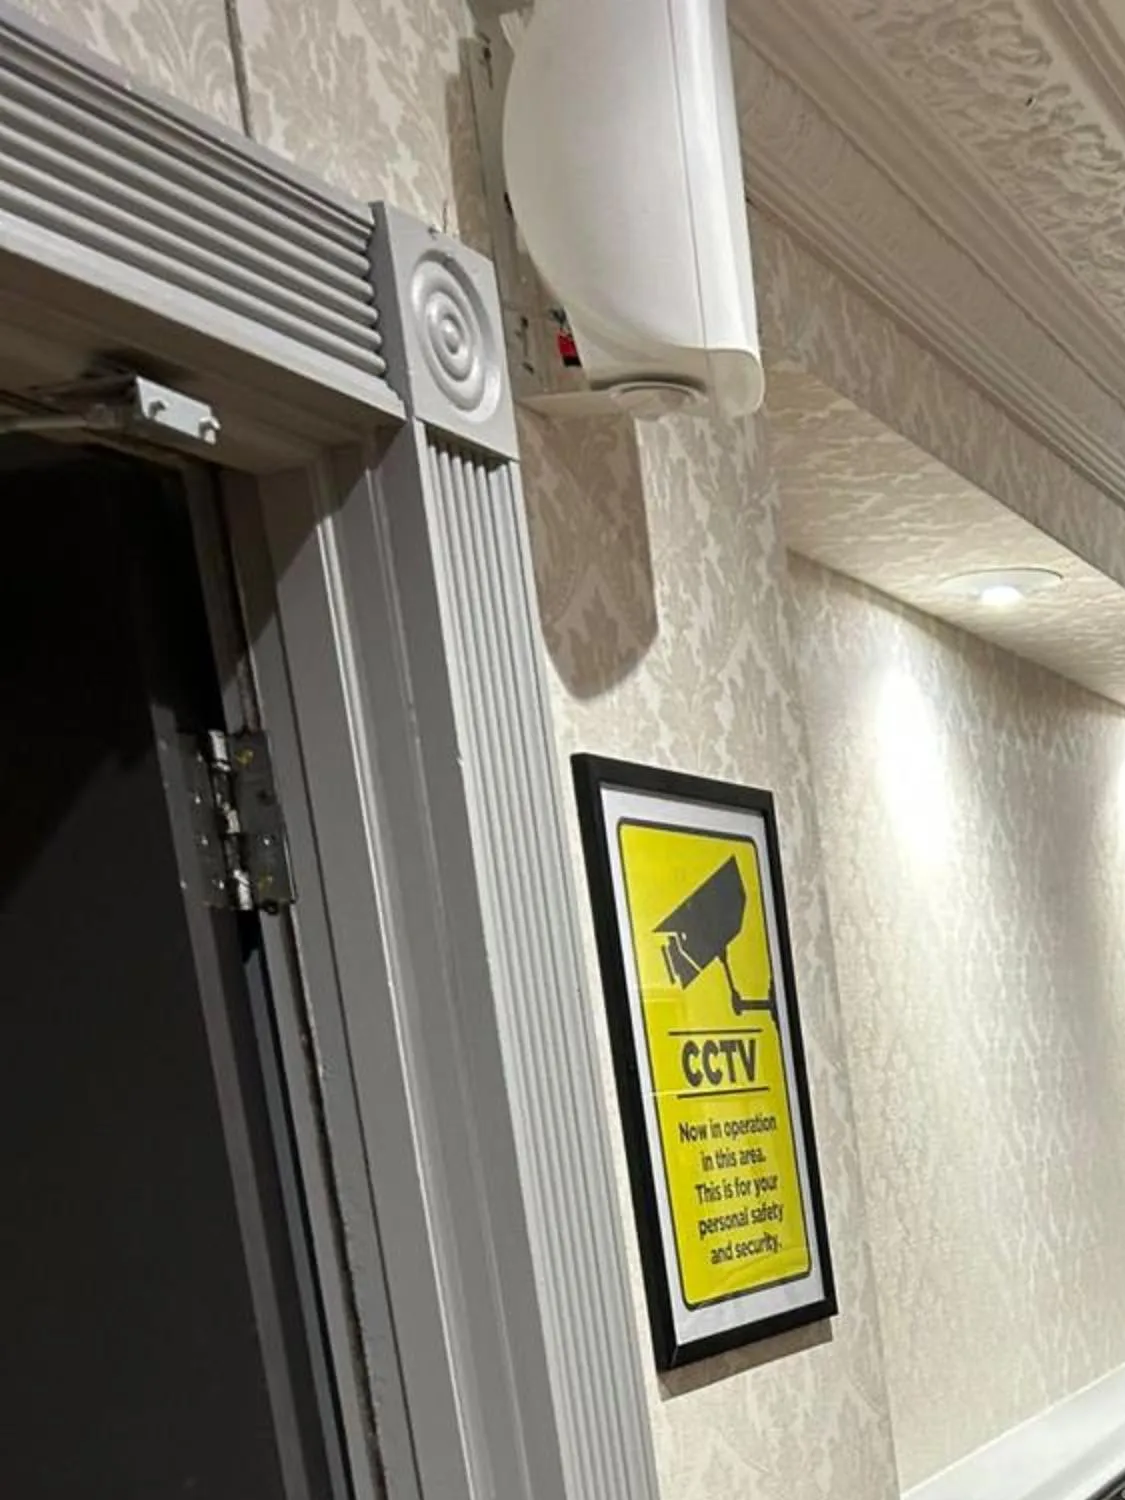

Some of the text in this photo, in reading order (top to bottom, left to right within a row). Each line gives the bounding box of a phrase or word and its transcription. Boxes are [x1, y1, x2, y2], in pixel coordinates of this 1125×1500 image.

[682, 1039, 756, 1087] CCTV
[679, 1113, 777, 1142] Now in operation
[700, 1151, 714, 1172] in
[715, 1147, 737, 1169] this
[695, 1175, 778, 1204] This is for your
[698, 1201, 784, 1240] personal safety
[711, 1240, 733, 1264] and
